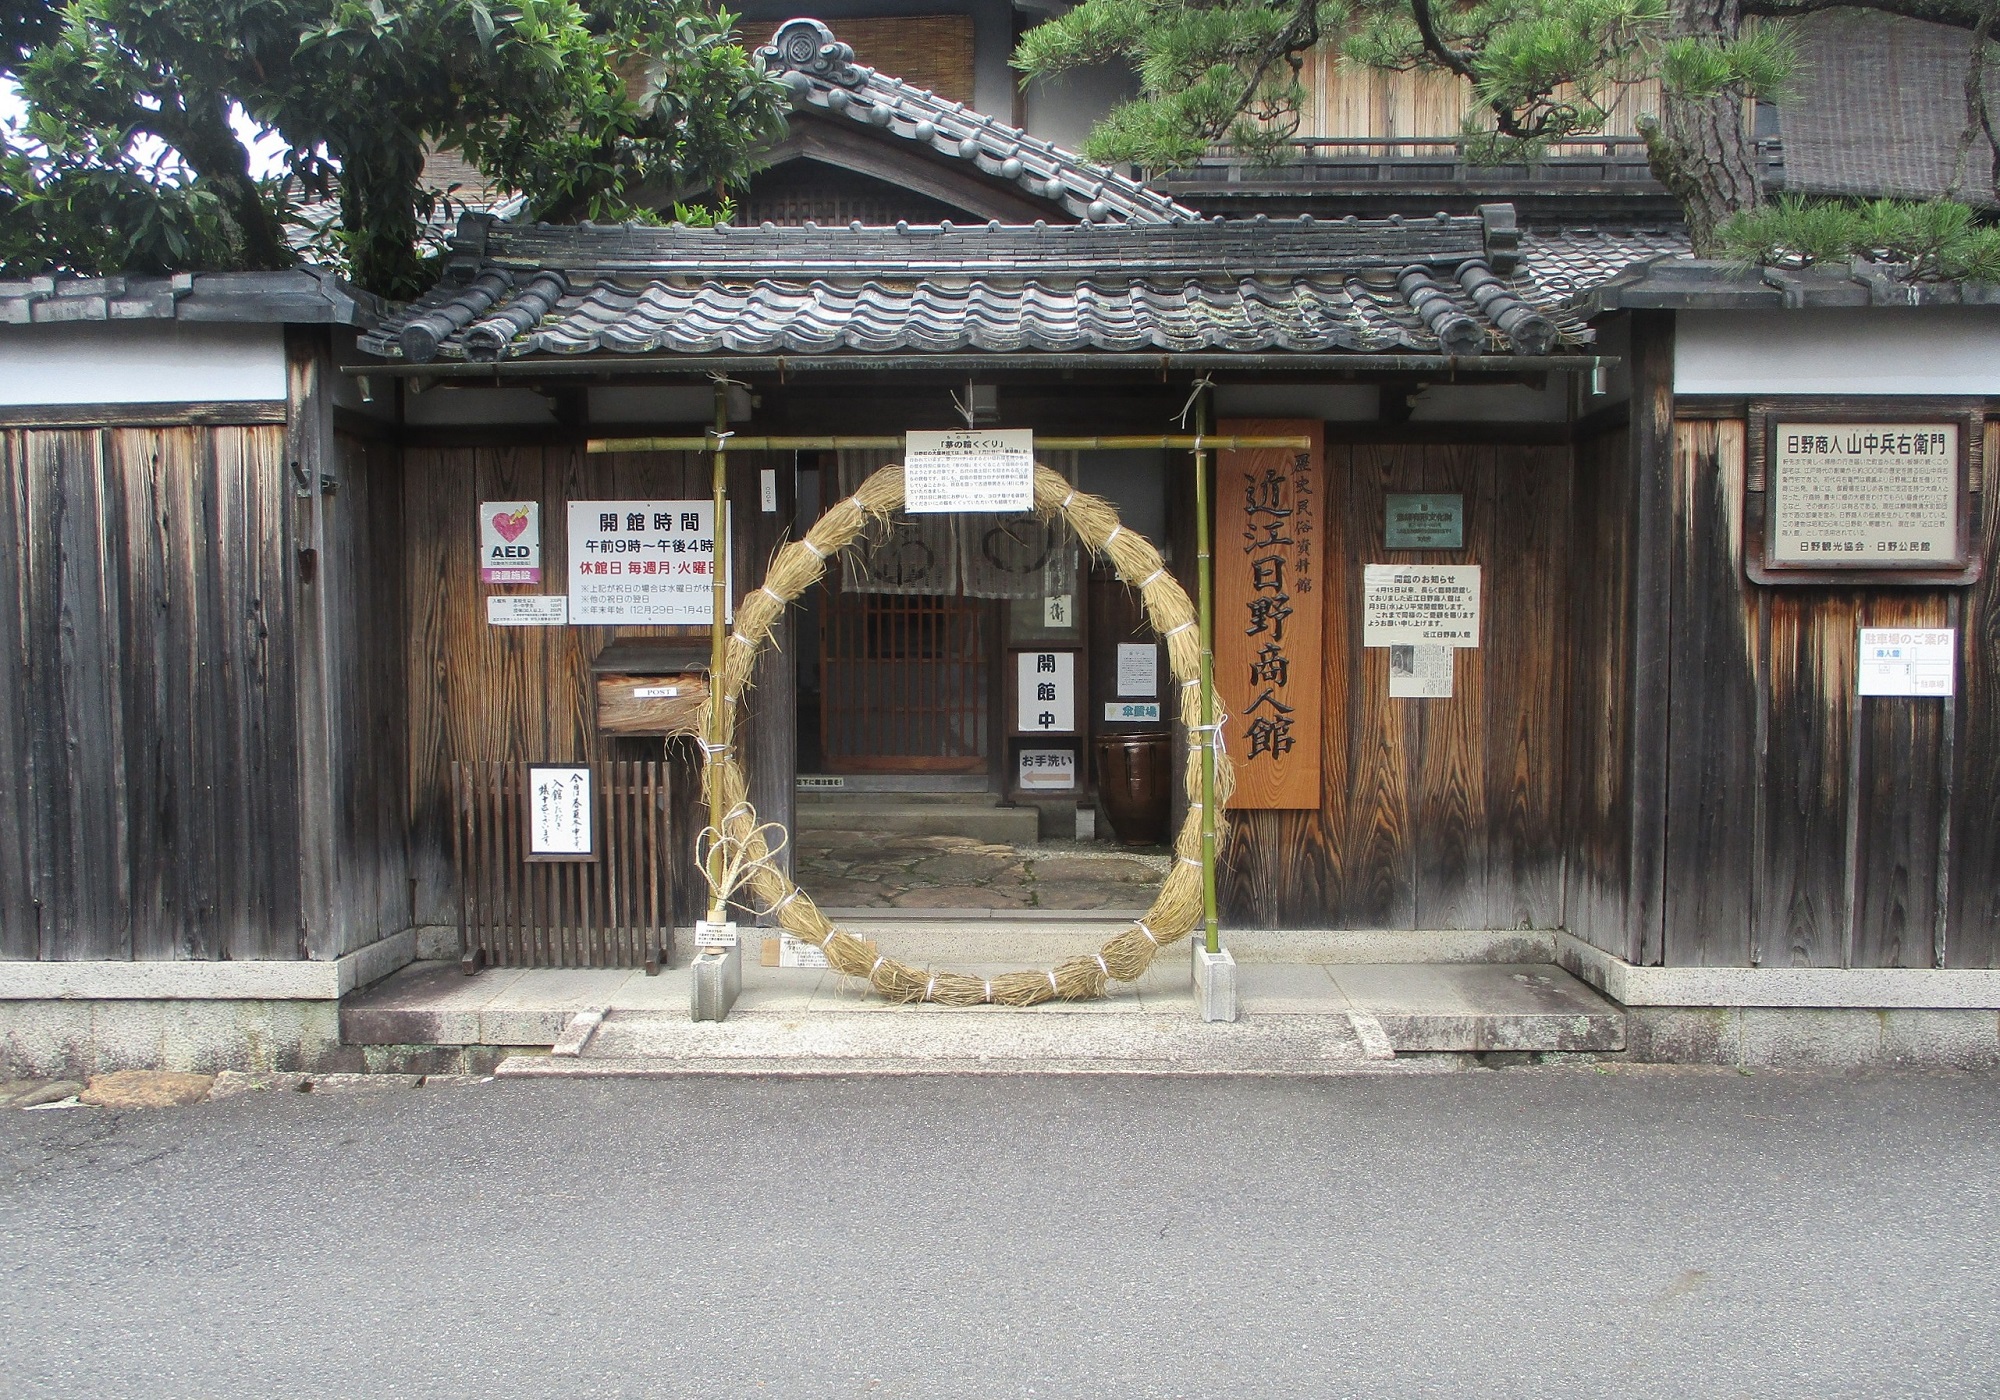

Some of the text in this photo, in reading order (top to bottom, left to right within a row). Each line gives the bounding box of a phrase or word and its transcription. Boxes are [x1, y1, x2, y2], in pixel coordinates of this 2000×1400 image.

[1787, 433, 1945, 455] 日野商人 山中兵右衛門
[600, 513, 699, 532] 開館時間
[491, 546, 531, 557] AED
[580, 561, 622, 575] 休館日
[1394, 575, 1456, 584] 開館のお知らせ
[581, 606, 624, 614] ※年末年始
[1242, 469, 1298, 761] 近江日野商人館
[1865, 633, 1949, 645] 駐車場のご案内
[1920, 680, 1945, 688] 駐車場
[1036, 654, 1056, 729] 開館中
[1122, 705, 1157, 717] 傘置場
[1022, 755, 1073, 767] お手洗い
